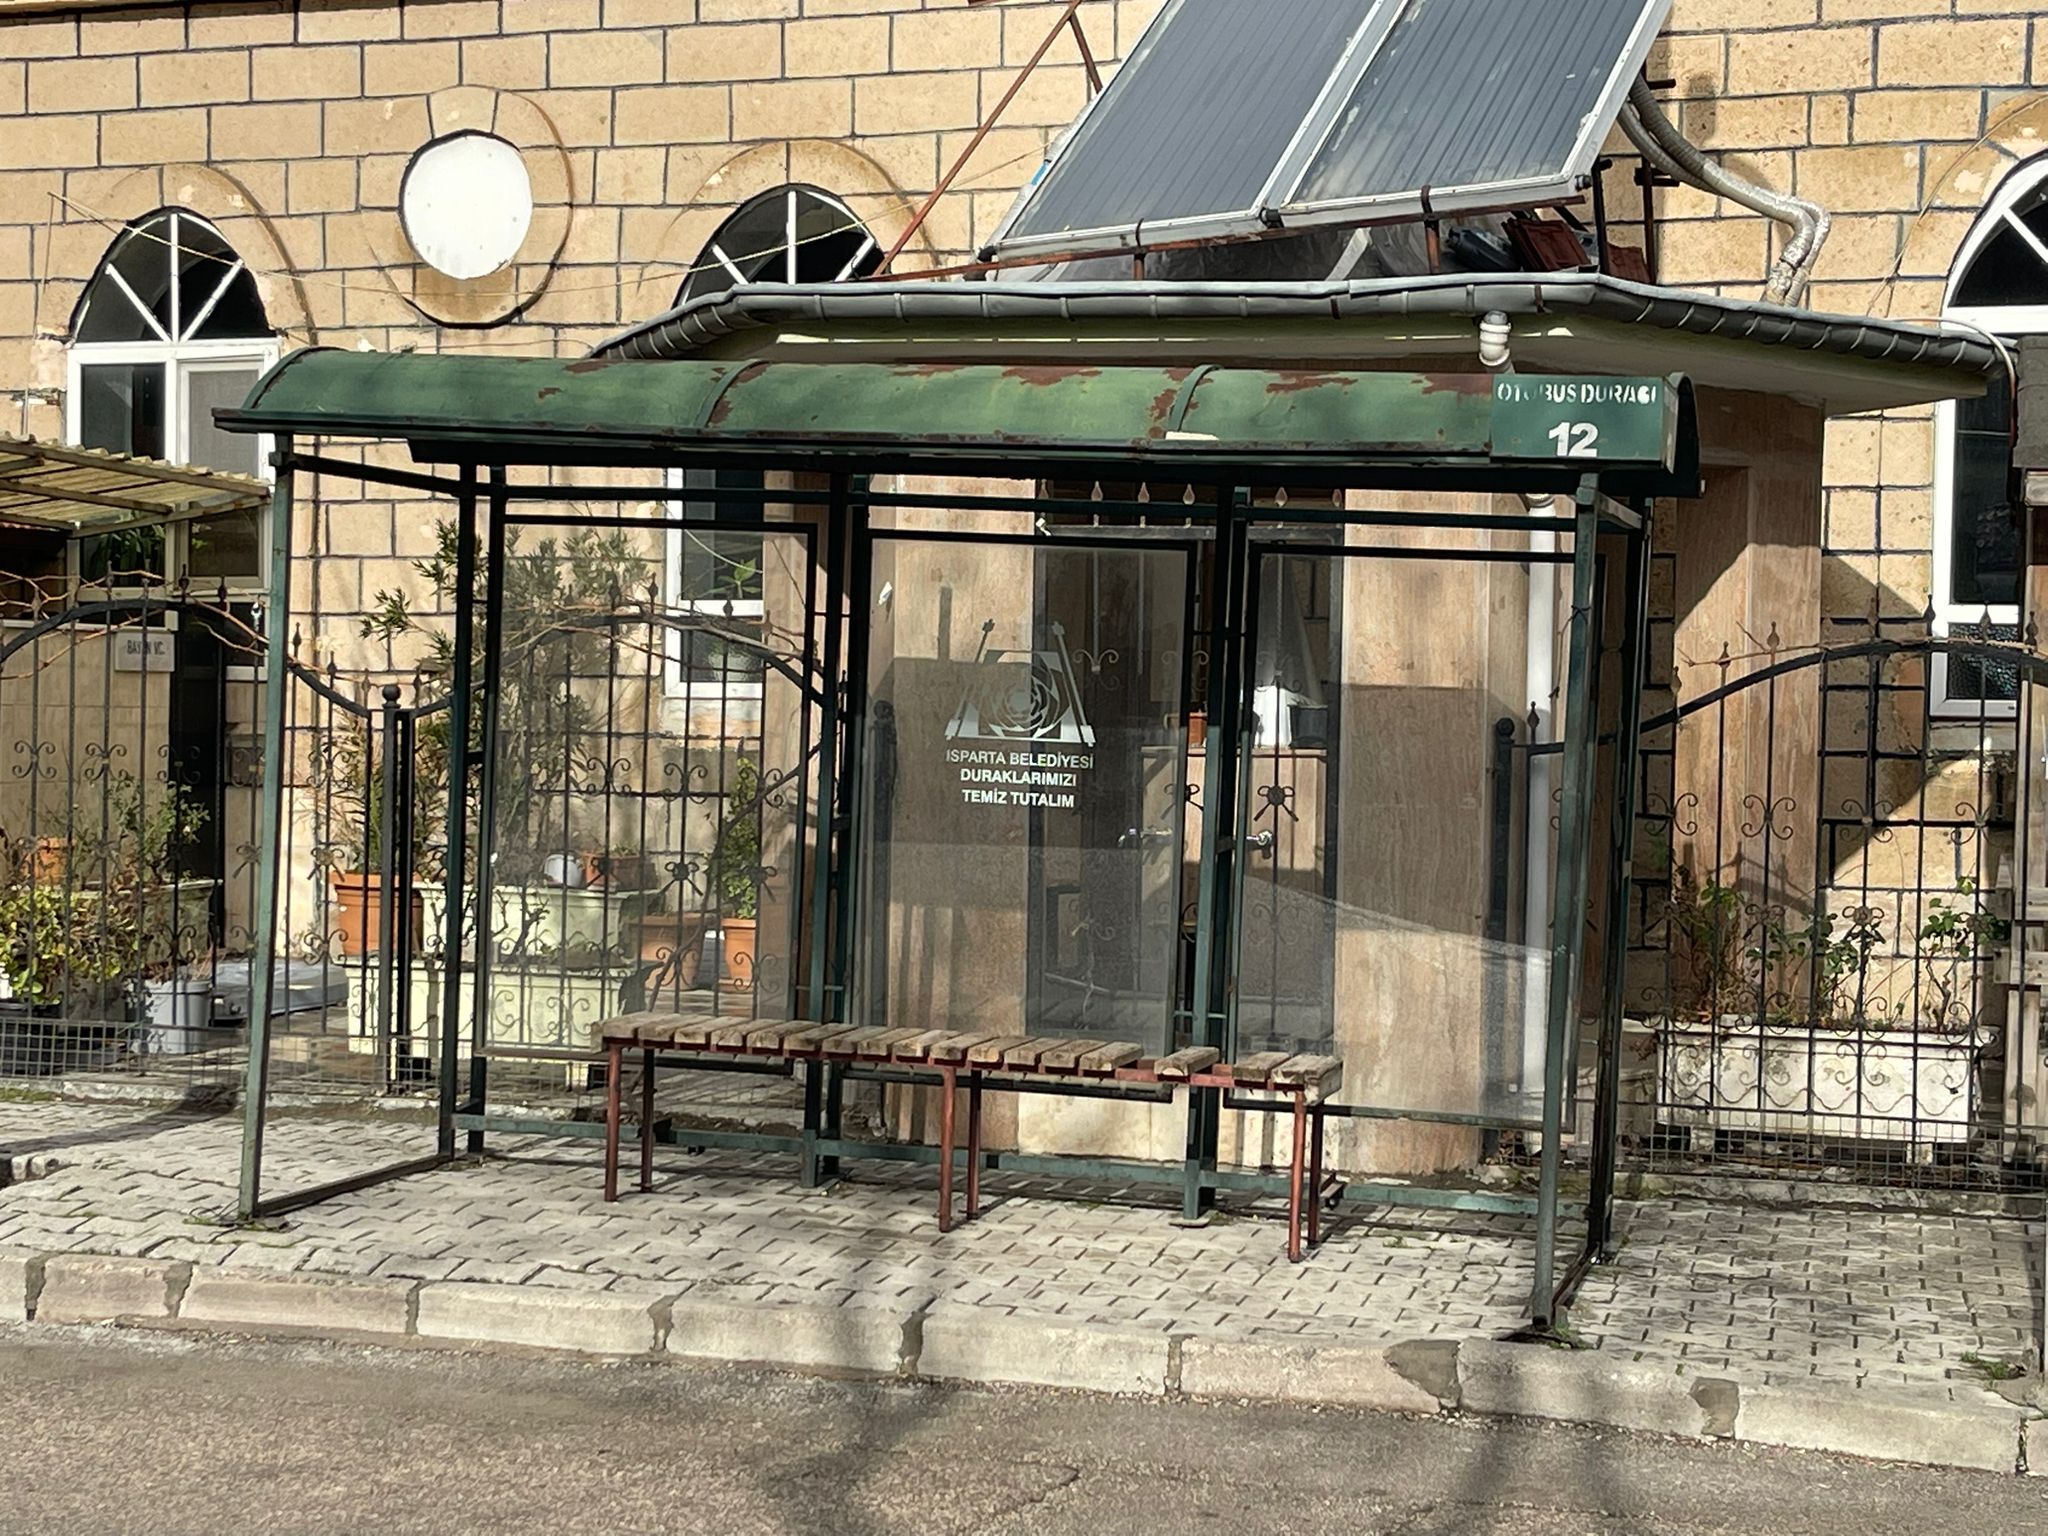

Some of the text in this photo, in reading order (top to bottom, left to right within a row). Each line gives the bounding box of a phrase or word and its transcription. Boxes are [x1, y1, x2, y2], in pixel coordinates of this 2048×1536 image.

[1548, 421, 1599, 457] 12
[945, 748, 1094, 770] ISPARTA BELEDİYESİ
[960, 768, 1077, 787] DURAKLARIMIZI
[962, 788, 1075, 808] TEMİZ TUTALIM
